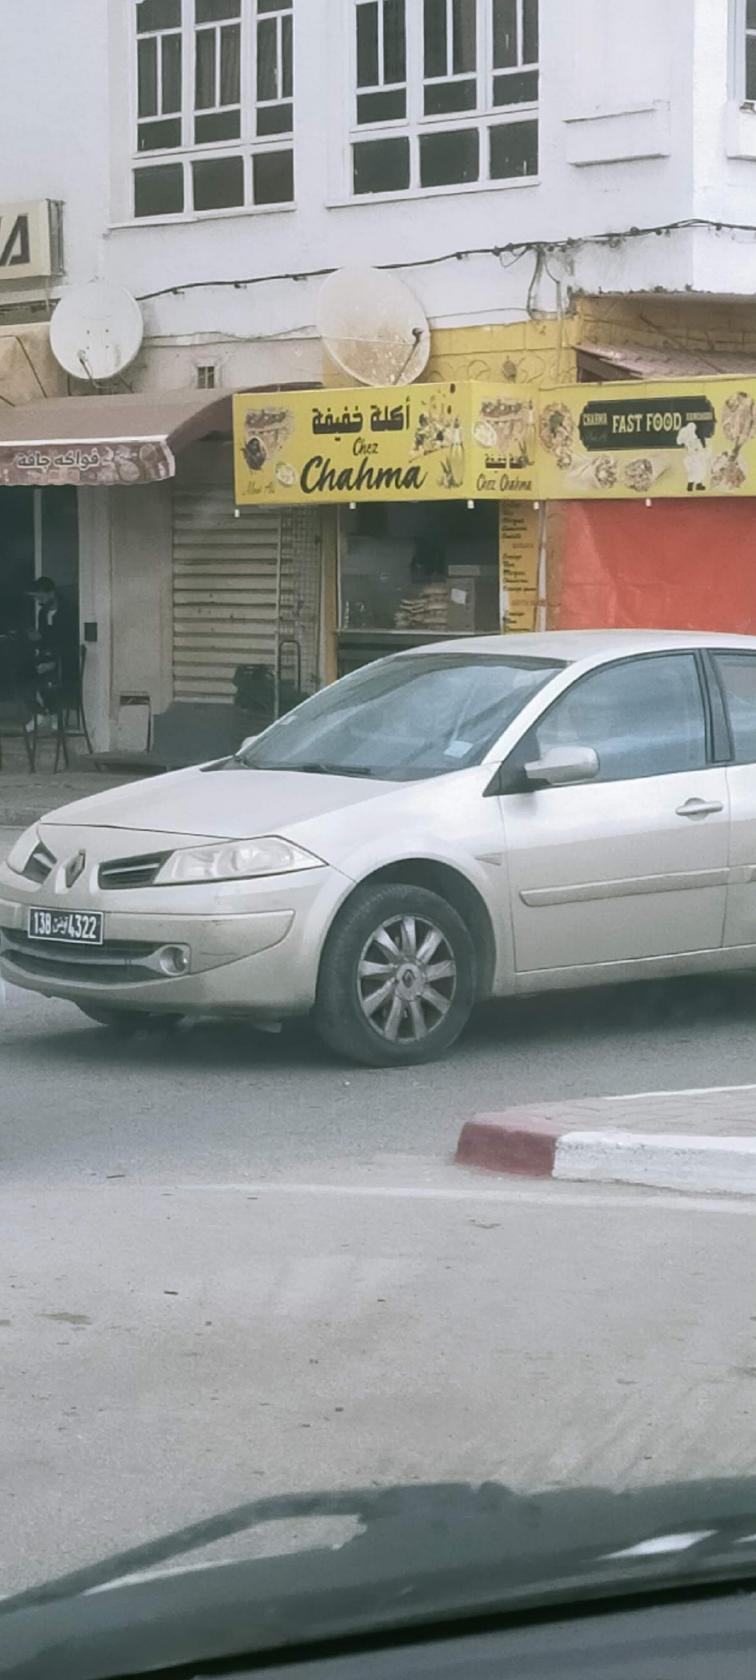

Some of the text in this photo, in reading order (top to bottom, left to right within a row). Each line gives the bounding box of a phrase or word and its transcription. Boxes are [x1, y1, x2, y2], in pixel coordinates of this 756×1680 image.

[0, 213, 30, 266] A
[312, 397, 410, 441] أكلة خفيفة
[612, 413, 643, 433] FAST
[646, 412, 682, 431] FOOD
[353, 436, 379, 456] Chez
[15, 447, 100, 473] فواكه جافة
[300, 455, 429, 493] Chahma
[34, 911, 51, 935] 138
[68, 914, 97, 938] 4322
